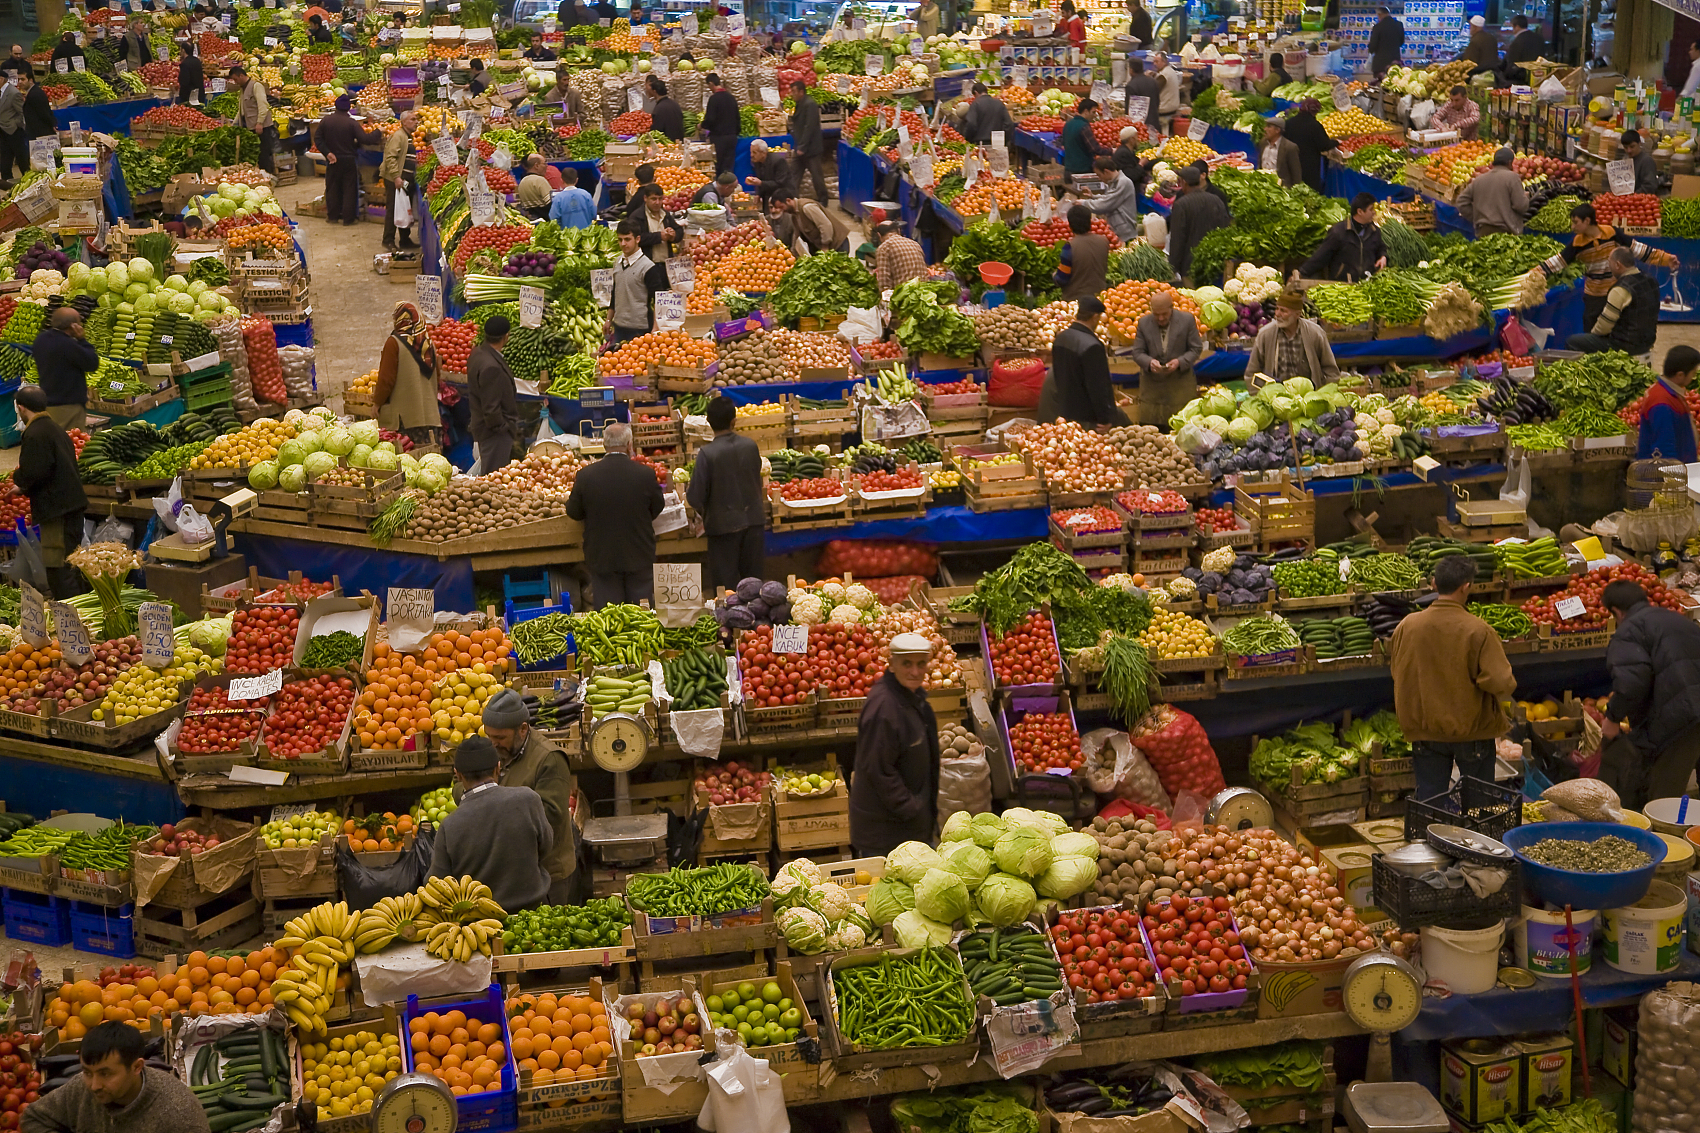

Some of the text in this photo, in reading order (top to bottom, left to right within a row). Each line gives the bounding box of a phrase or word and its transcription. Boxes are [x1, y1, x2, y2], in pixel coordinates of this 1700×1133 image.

[658, 584, 700, 604] 3500
[22, 606, 44, 625] 250
[142, 612, 170, 622] GOLDEN
[150, 621, 172, 632] ELMA
[61, 630, 86, 645] 250
[146, 632, 172, 648] 250
[775, 640, 806, 652] KABUK
[230, 682, 278, 699] DOMATES
[1539, 1058, 1564, 1070] Hisar
[1488, 1068, 1511, 1082] Hisar
[532, 1080, 609, 1102] KORKUSUZ
[532, 1102, 610, 1125] KORKUSUZ
